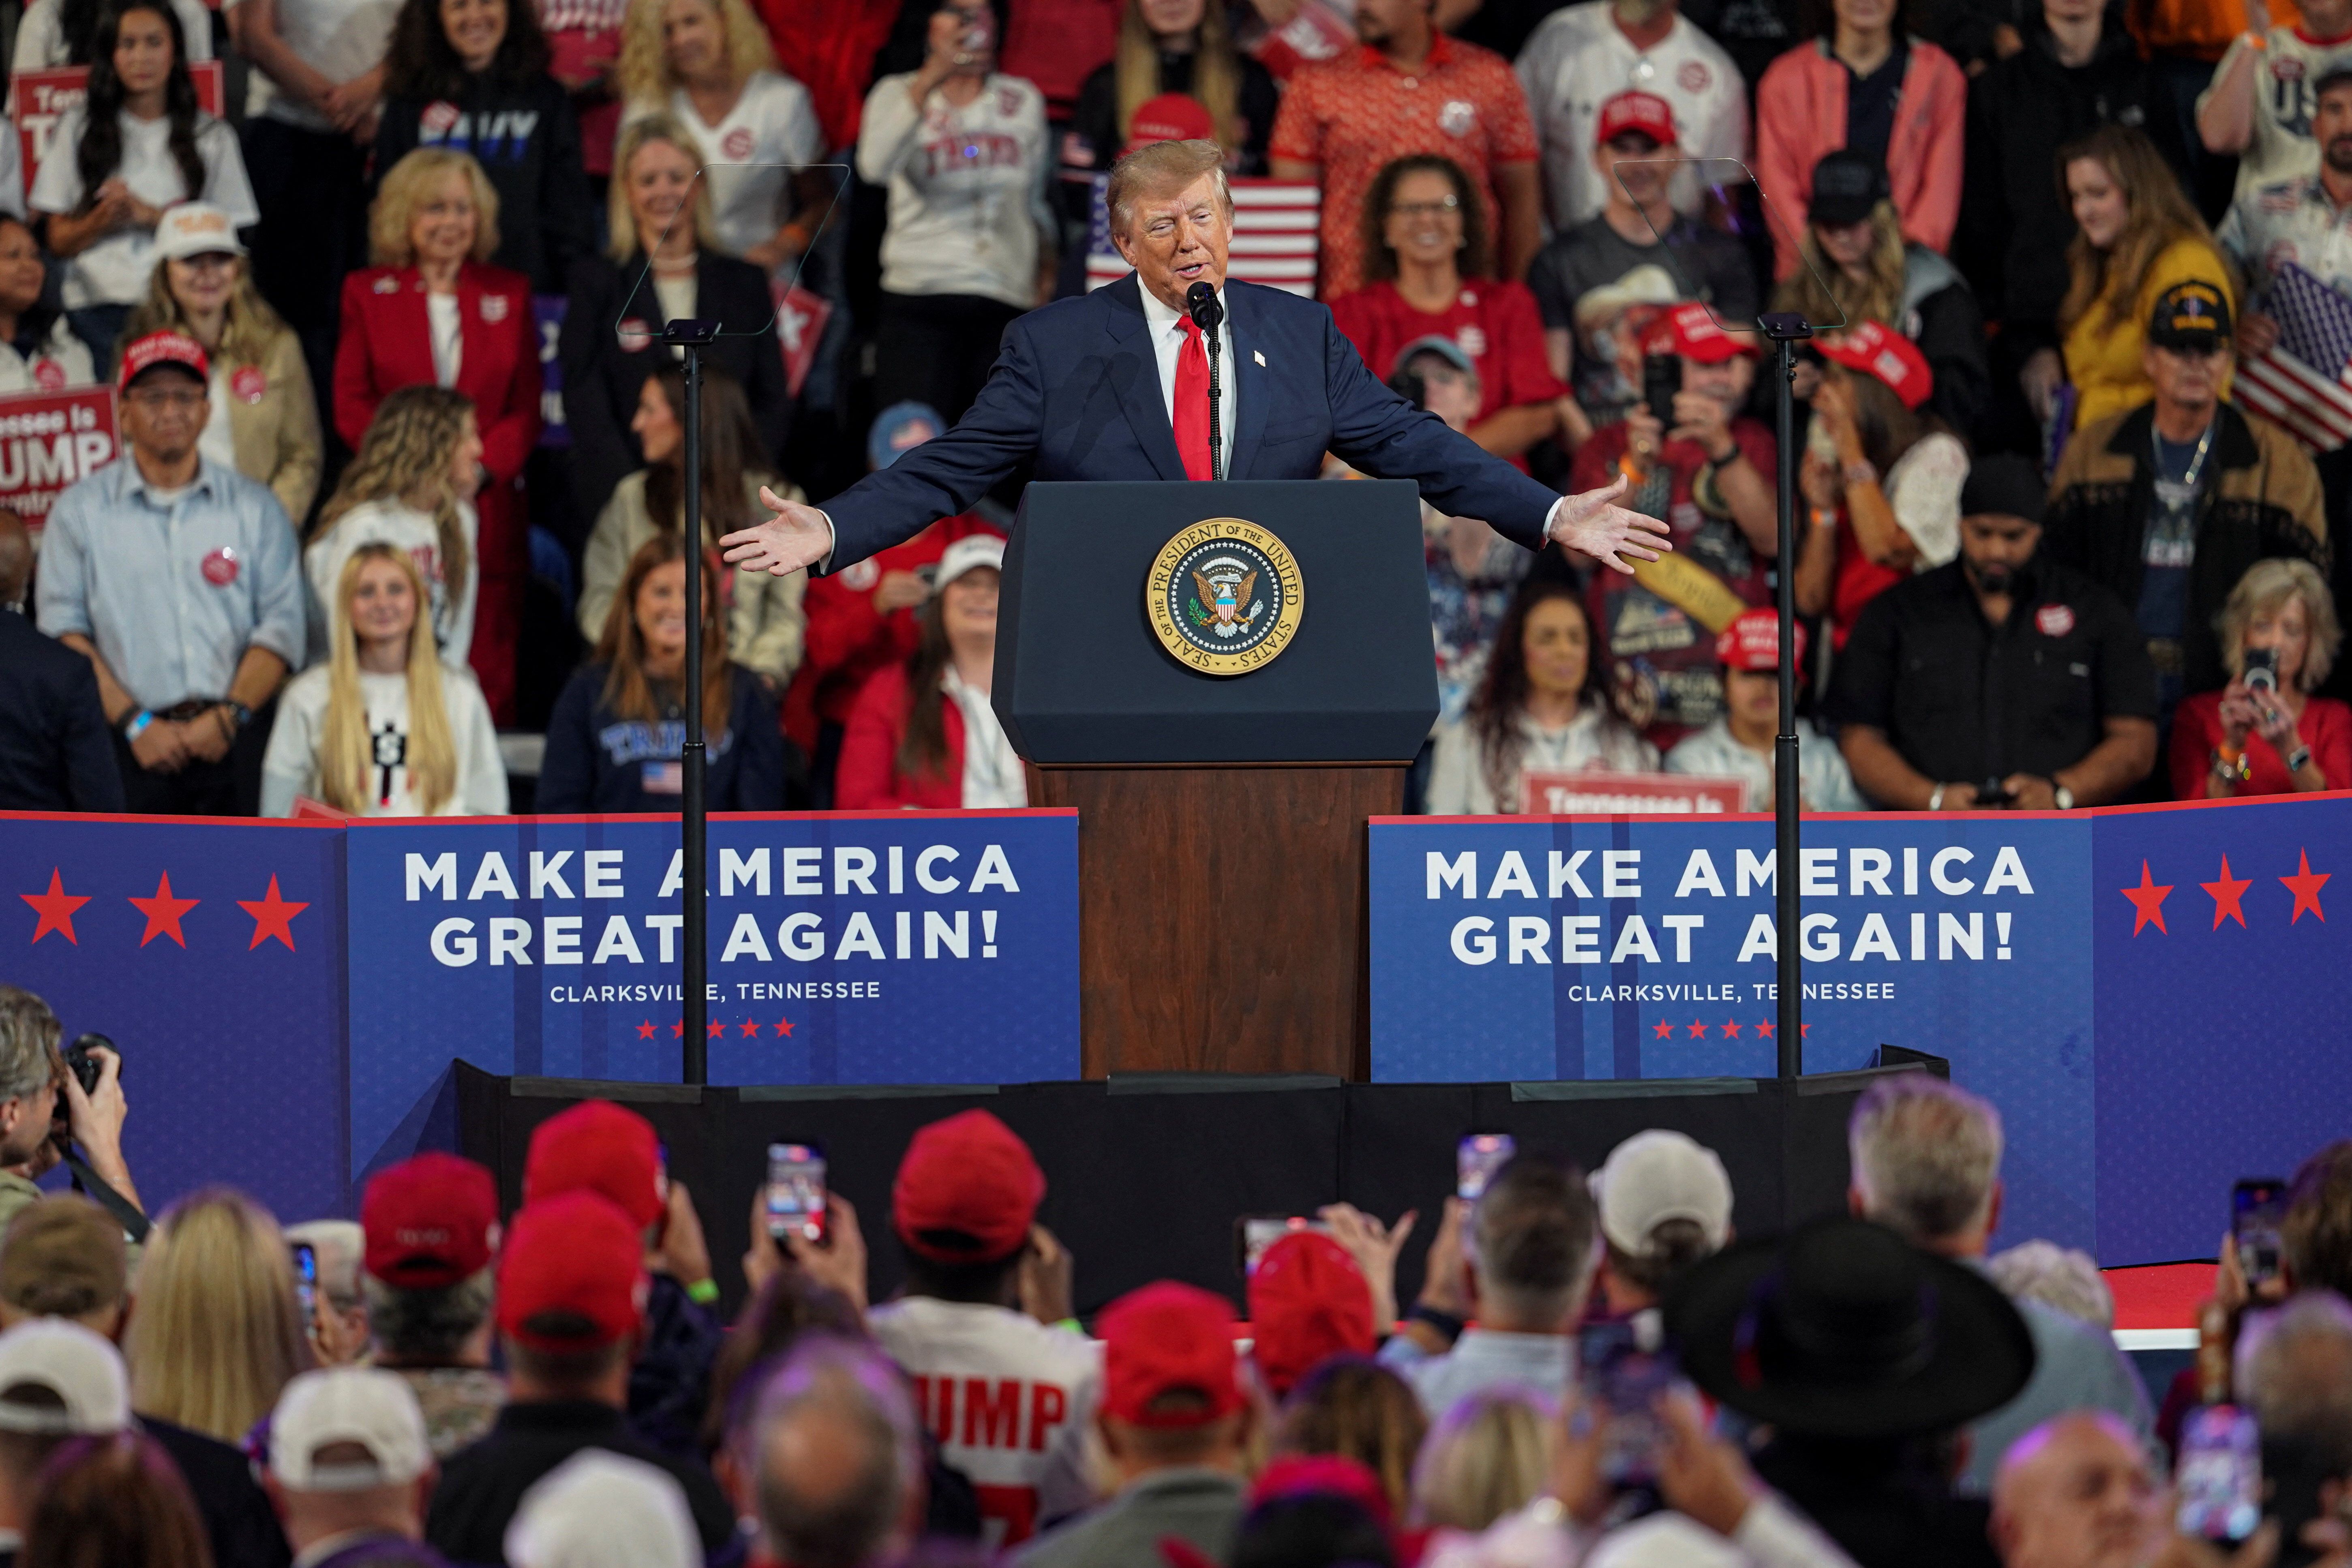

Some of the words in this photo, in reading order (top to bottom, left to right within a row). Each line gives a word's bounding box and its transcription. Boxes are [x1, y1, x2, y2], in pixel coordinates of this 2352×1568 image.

[1226, 525, 1241, 535] OF
[1244, 529, 1263, 543] THE
[1153, 524, 1221, 592] PRESIDENT
[1266, 542, 1298, 606] UNITED
[1155, 598, 1167, 620] THE
[1161, 623, 1173, 636] OF
[1170, 643, 1212, 667] SEAL
[1240, 620, 1292, 667] STATES
[405, 850, 624, 901] MAKE
[658, 844, 1020, 897] AMERICA
[1426, 850, 1642, 899] MAKE
[1675, 846, 2035, 897] AMERICA
[430, 915, 684, 967] GREAT
[720, 910, 998, 962] AGAIN!
[1450, 915, 1704, 965] GREAT
[1737, 912, 2012, 962] AGAIN!
[550, 984, 726, 1003] CLARKSVILE,
[737, 981, 880, 1000] TENNESSEE
[1568, 984, 1742, 1003] CLARKSVILLE,
[1752, 983, 1895, 1000] TENESSEE
[913, 1374, 1068, 1450] UMP
